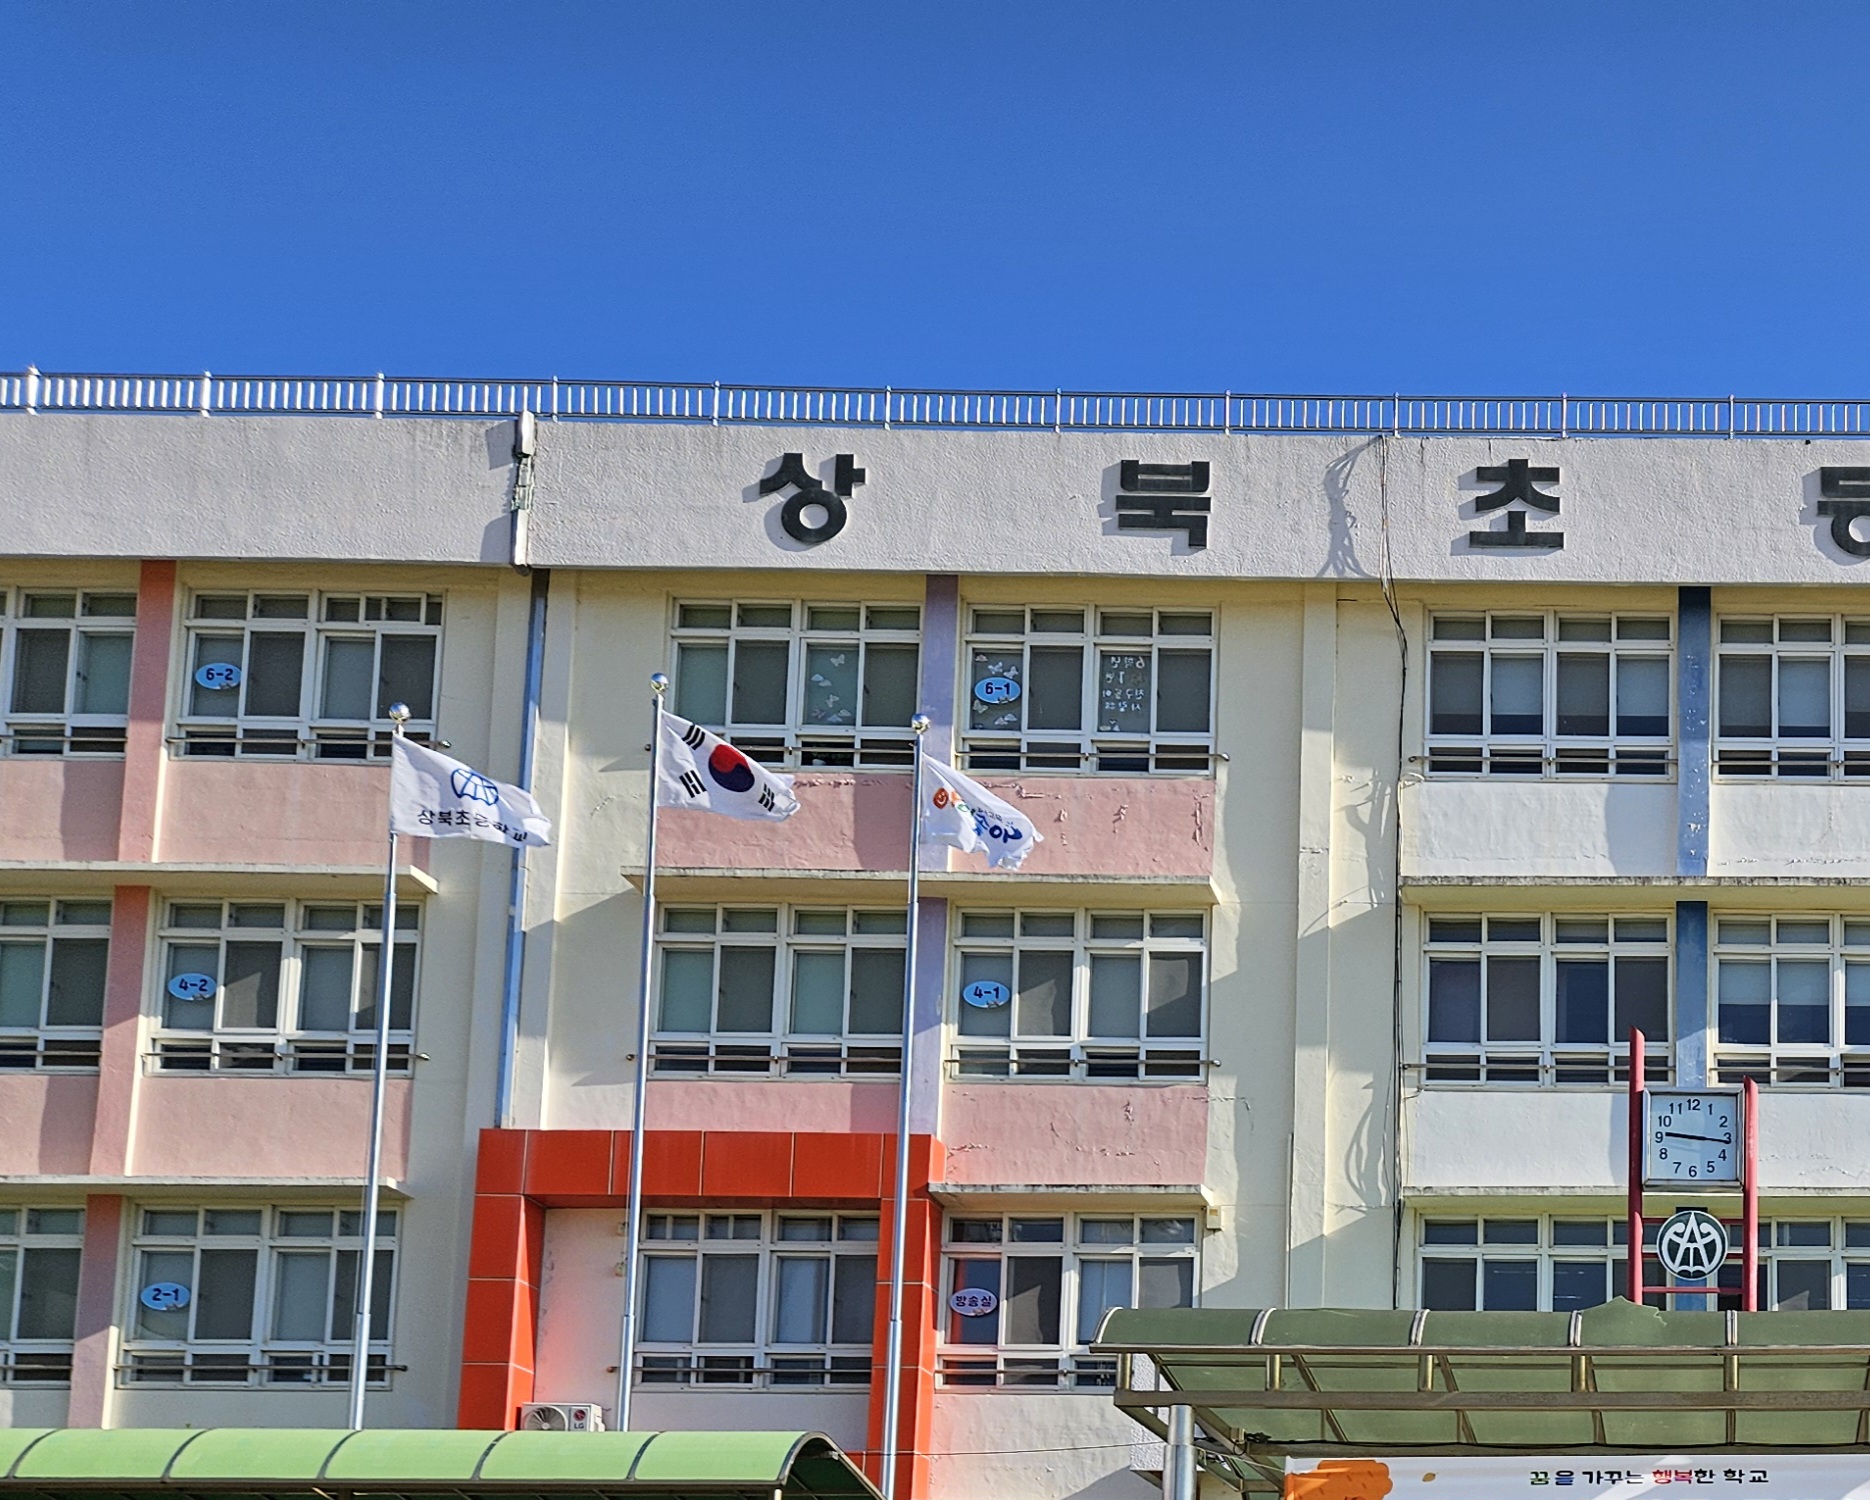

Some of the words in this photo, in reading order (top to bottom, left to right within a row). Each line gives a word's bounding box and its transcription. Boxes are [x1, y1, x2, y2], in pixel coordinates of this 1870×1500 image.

[206, 668, 234, 681] 6-2
[986, 682, 1010, 695] 6-1
[179, 979, 208, 992] 4-2
[974, 986, 999, 999] 4-1
[1669, 1103, 1682, 1115] 11
[1686, 1098, 1701, 1111] 12
[1707, 1103, 1713, 1116] 1
[1658, 1115, 1672, 1128] 10
[1719, 1115, 1728, 1128] 2
[1655, 1131, 1664, 1144] 9
[1723, 1132, 1732, 1145] 3
[1659, 1147, 1668, 1160] 8
[1718, 1149, 1727, 1162] 4
[1672, 1162, 1682, 1174] 7
[1688, 1165, 1698, 1178] 6
[1706, 1161, 1716, 1174] 5
[152, 1288, 179, 1301] 2-1
[956, 1294, 992, 1307] 방송실
[574, 1422, 585, 1430] LG
[1529, 1470, 1575, 1486] 꿈을
[1582, 1469, 1644, 1486] 가꾸는
[1652, 1468, 1716, 1485] 행복한
[1722, 1468, 1769, 1484] 학교
